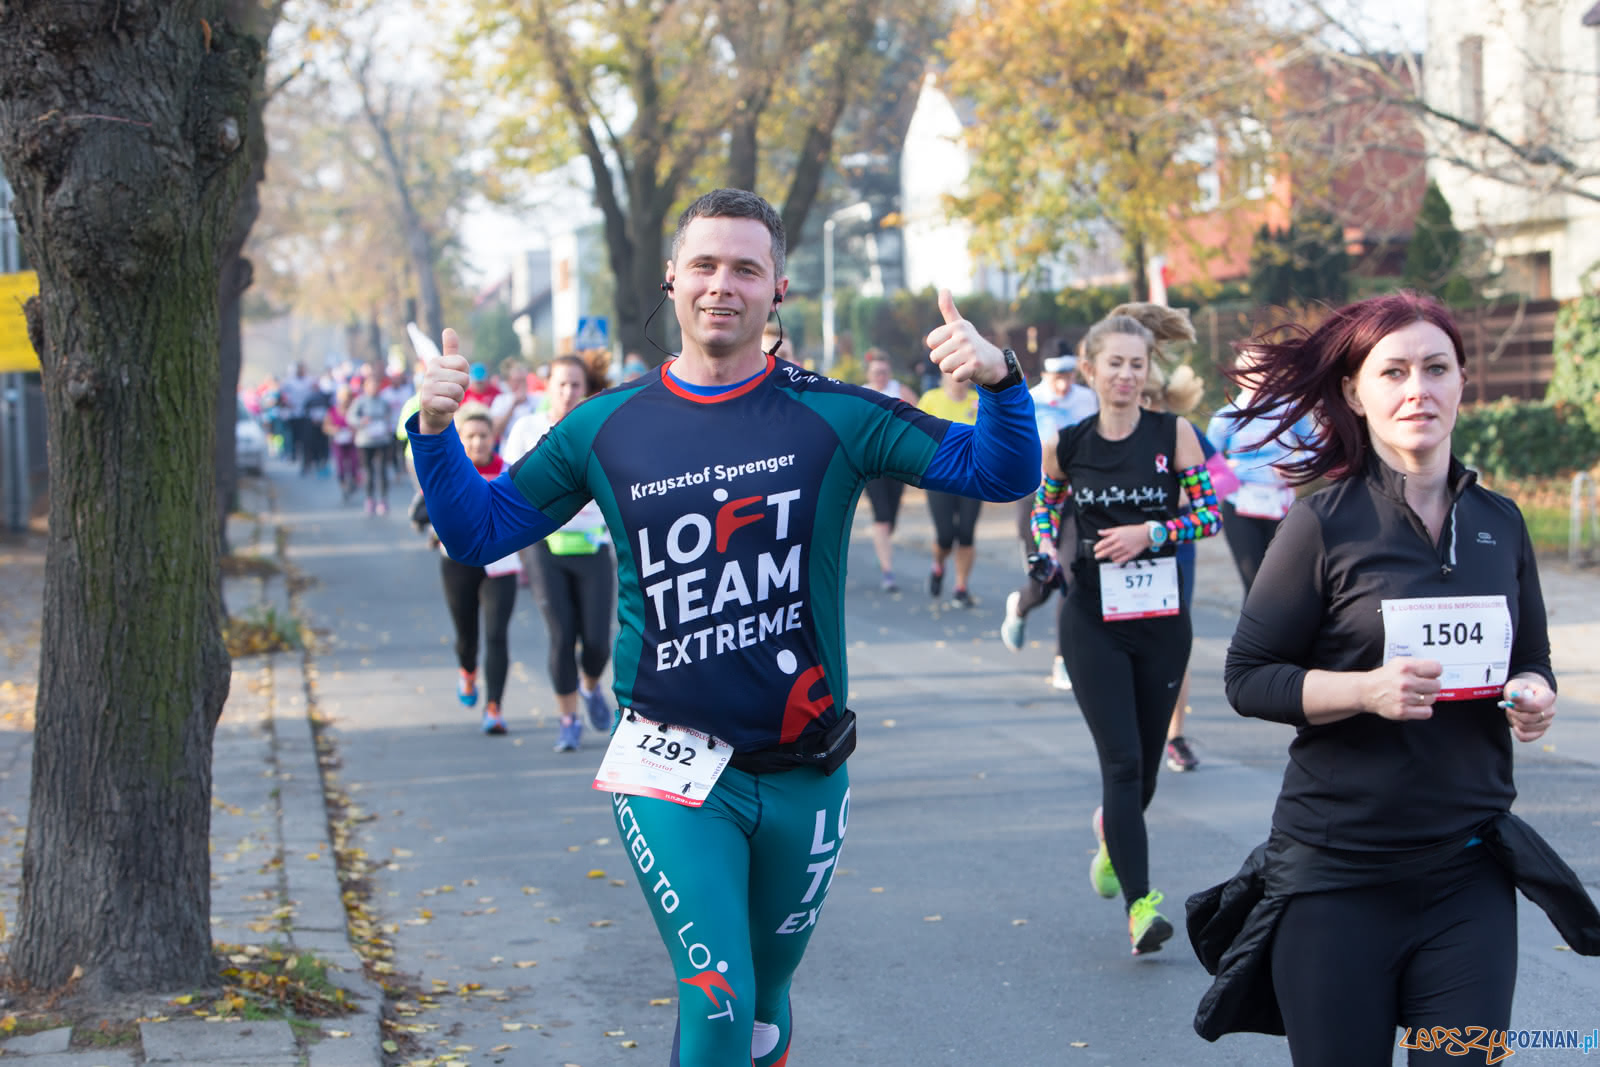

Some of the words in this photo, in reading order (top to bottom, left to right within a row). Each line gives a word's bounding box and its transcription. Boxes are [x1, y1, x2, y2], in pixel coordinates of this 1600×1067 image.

[631, 467, 710, 500] Krzysztof
[714, 454, 795, 481] Sprenger
[638, 488, 801, 578] LOFT
[646, 544, 801, 631] TEAM
[1125, 574, 1153, 589] 577
[656, 601, 803, 671] EXTREME
[1422, 622, 1483, 646] 1504
[636, 733, 697, 767] 1292
[653, 872, 680, 914] TO
